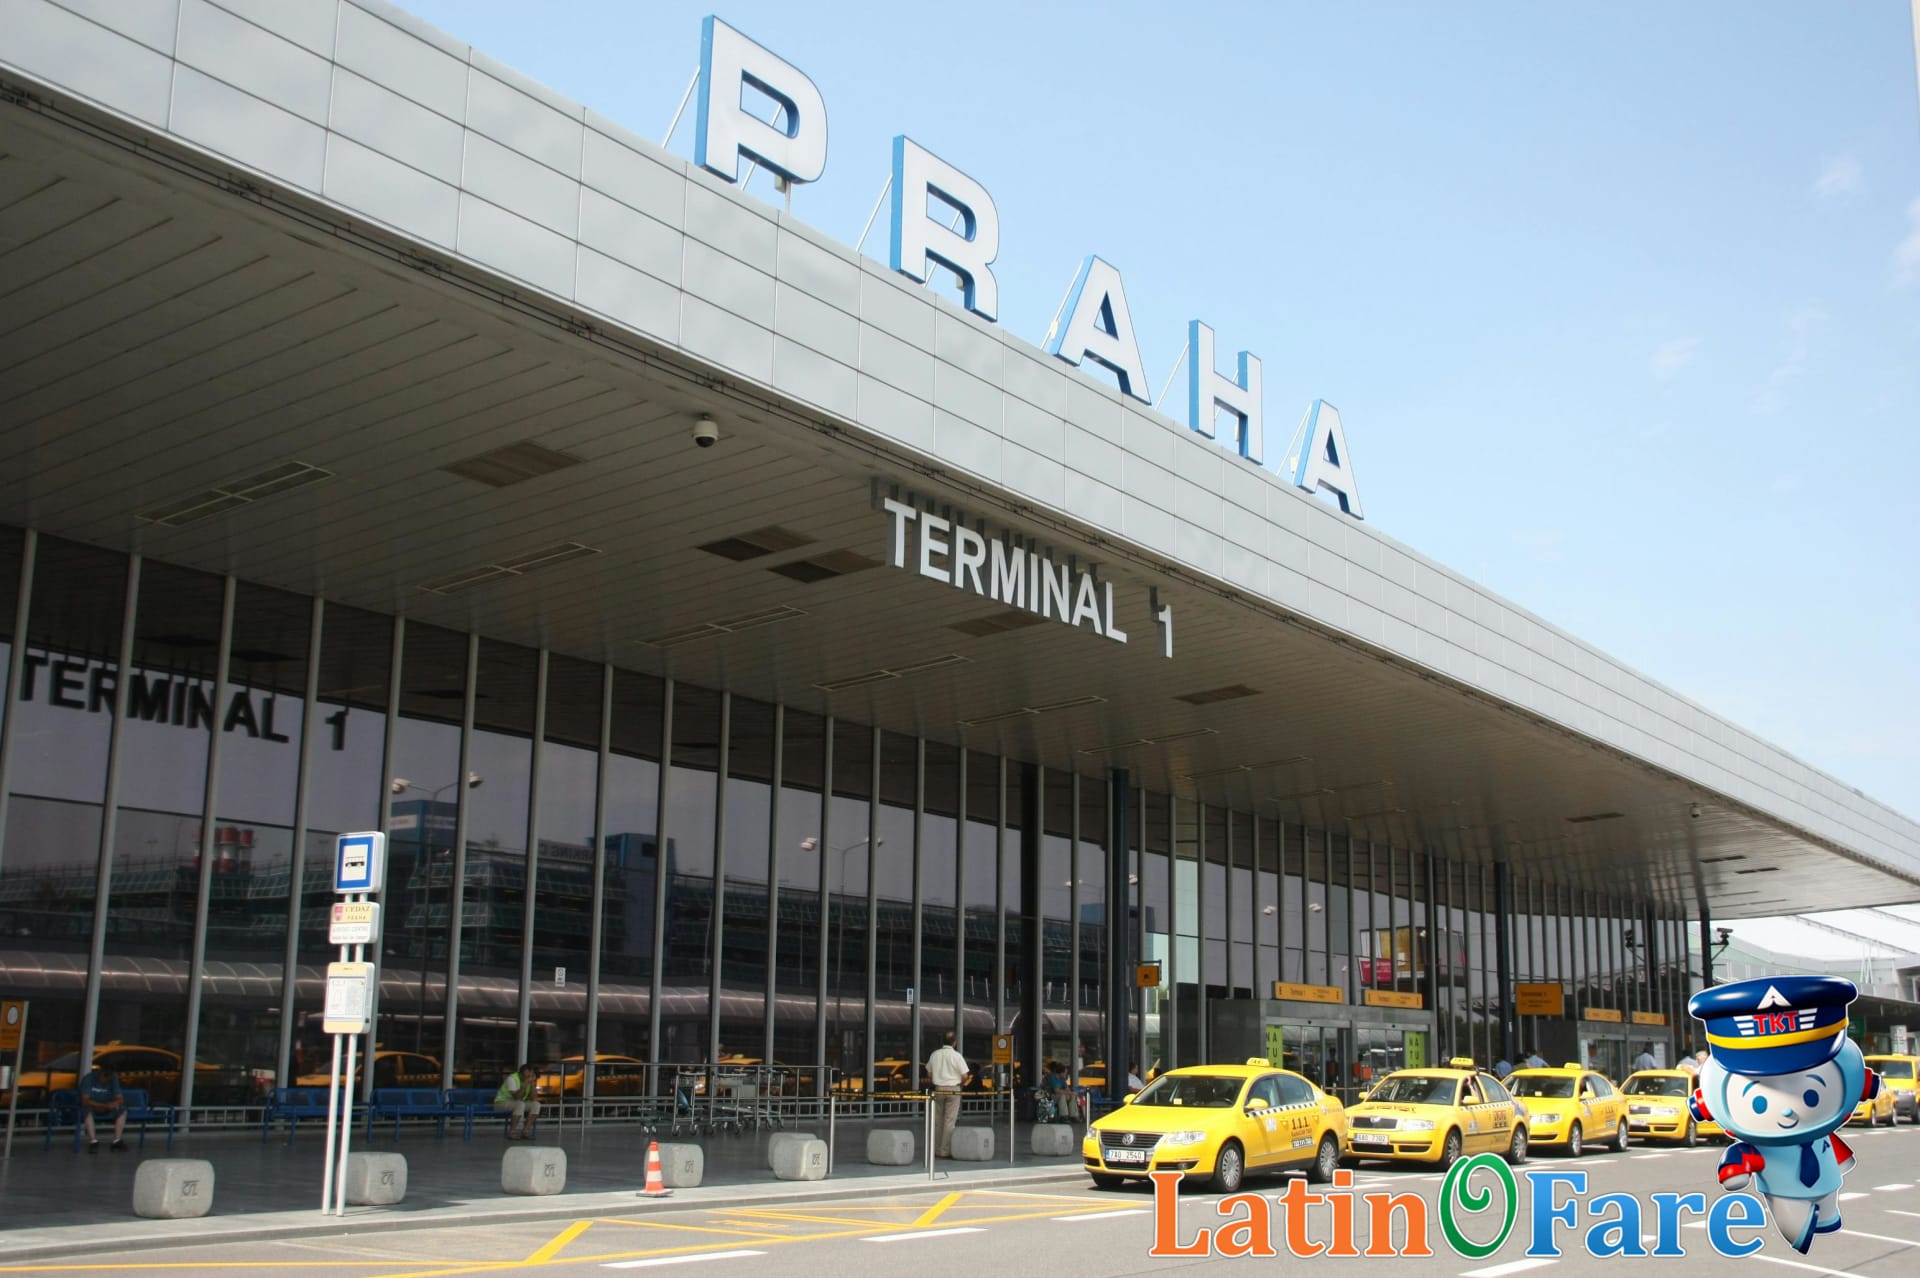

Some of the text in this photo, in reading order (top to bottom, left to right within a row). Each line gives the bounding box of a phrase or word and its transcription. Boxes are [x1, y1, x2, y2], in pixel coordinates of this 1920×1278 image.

[695, 15, 1364, 520] PRAHA
[884, 497, 1173, 658] TERMINAL 1
[20, 654, 349, 750] TERMINAL 1
